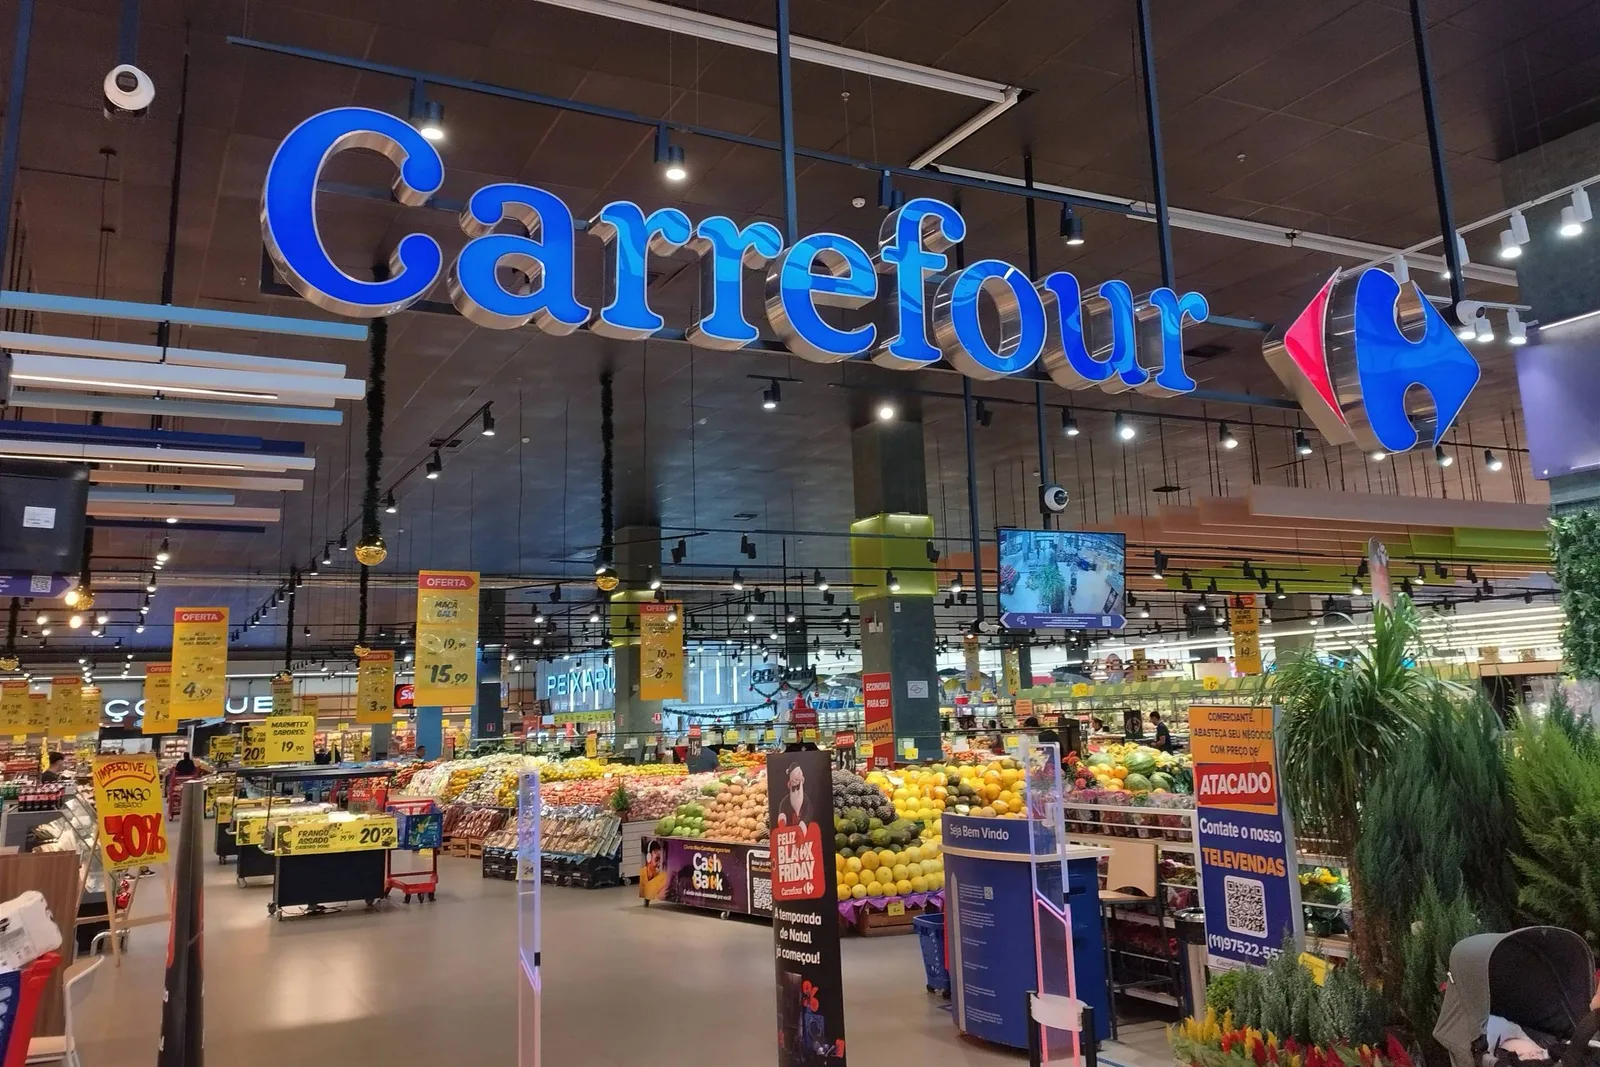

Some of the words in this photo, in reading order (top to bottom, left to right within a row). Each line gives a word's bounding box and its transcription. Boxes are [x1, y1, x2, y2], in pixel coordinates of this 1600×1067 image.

[262, 106, 1209, 397] Carrefour
[427, 578, 467, 587] OFERTA
[646, 604, 674, 612] OFERTA
[182, 613, 218, 621] OFERTA
[866, 682, 891, 692] ECONOMIA
[867, 699, 879, 708] PARA
[879, 698, 889, 707] SEU
[271, 721, 309, 729] MARMITEX
[1194, 728, 1227, 739] ABASTEÇA
[1228, 729, 1241, 739] SEU
[1210, 745, 1226, 755] COM
[1226, 746, 1248, 758] PREÇO
[1249, 747, 1259, 757] DE
[1199, 771, 1272, 796] ATACADO
[106, 788, 151, 803] FRANGO
[352, 789, 366, 798] 20%
[104, 813, 166, 863] 30%
[298, 829, 329, 838] FRANGO
[950, 823, 962, 838] Seja
[962, 825, 980, 838] Bem
[981, 826, 1009, 840] Vindo
[1200, 817, 1239, 838] Contate
[1241, 826, 1248, 839] o
[1250, 827, 1282, 844] nosso
[298, 837, 329, 845] ASSADO
[777, 831, 796, 846] FELIZ
[693, 852, 722, 873] Cash
[1202, 847, 1286, 878] TELEVENDAS
[778, 861, 816, 883] FRIDAY
[781, 886, 802, 896] Carrefour
[775, 907, 779, 919] A
[779, 908, 821, 925] temporada
[780, 927, 789, 939] de
[789, 928, 812, 944] Natal
[776, 944, 781, 959] já
[782, 948, 820, 966] começou!
